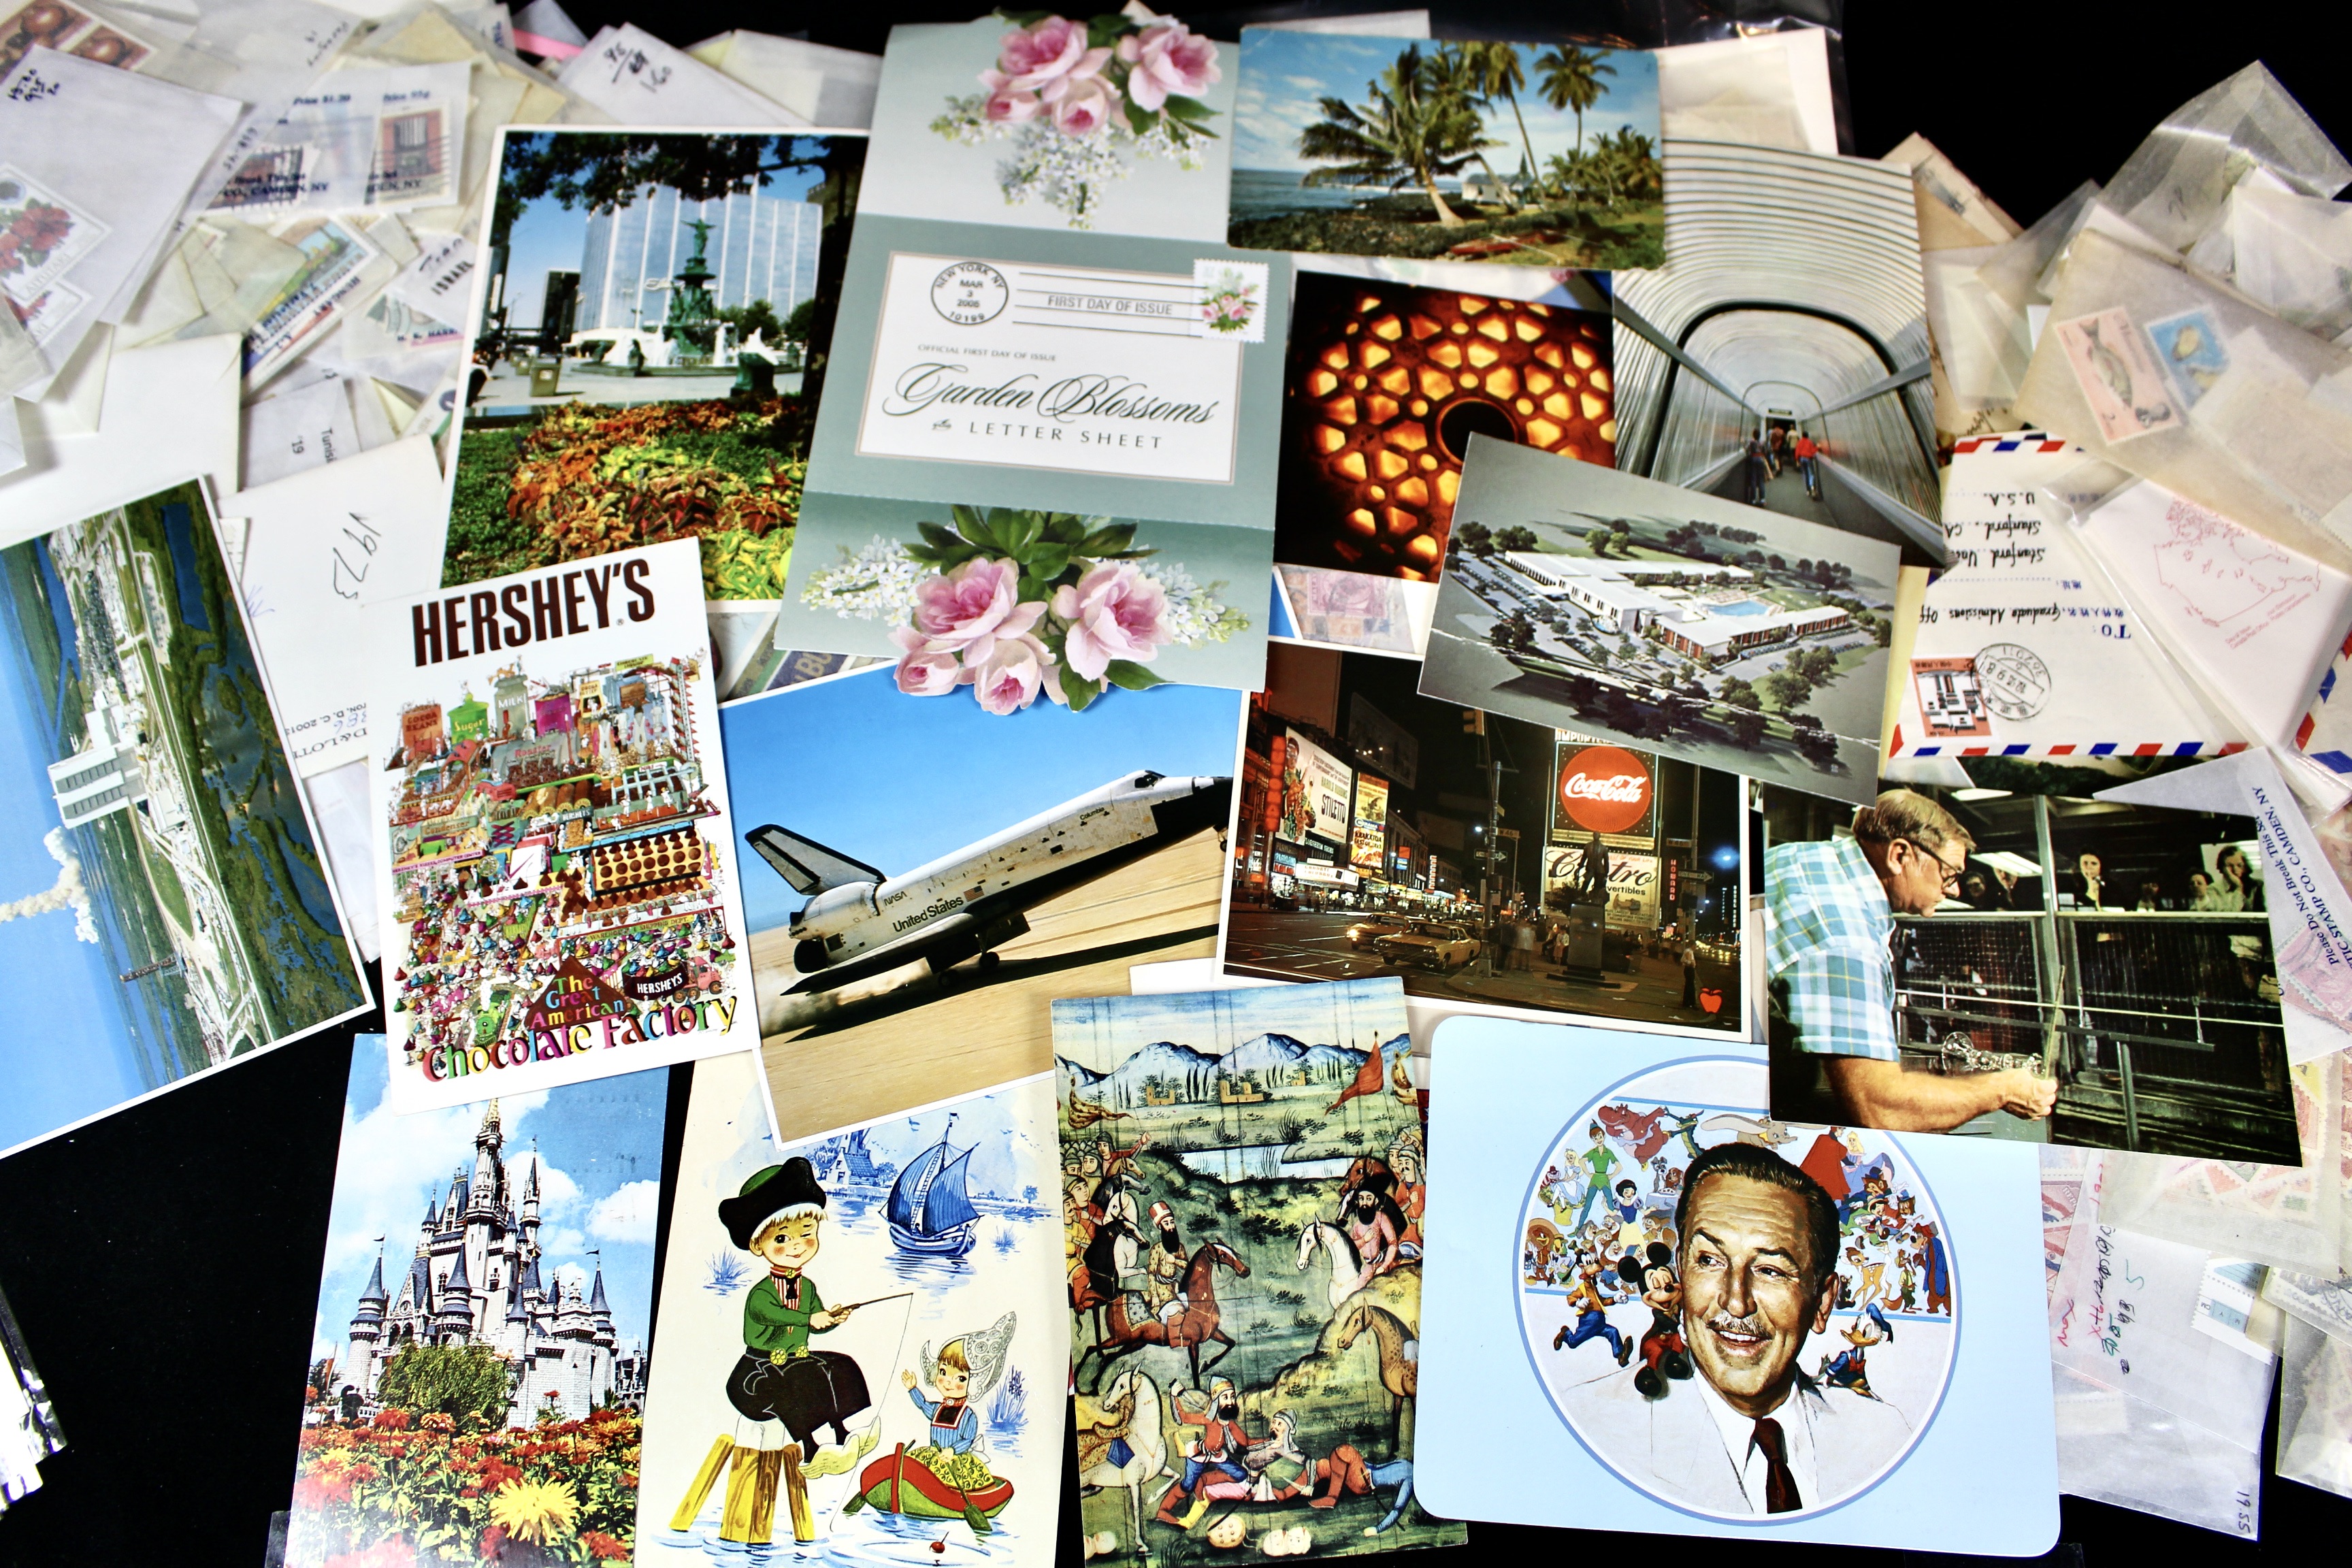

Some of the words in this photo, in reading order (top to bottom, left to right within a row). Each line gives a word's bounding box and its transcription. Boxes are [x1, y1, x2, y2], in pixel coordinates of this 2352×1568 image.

[935, 268, 956, 289] NEW
[958, 263, 991, 276] YORK
[991, 275, 1005, 289] NY
[960, 278, 983, 289] MAR
[1047, 294, 1083, 308] FIRST
[1087, 298, 1112, 310] DAY
[1115, 300, 1133, 312] OF
[1134, 302, 1174, 315] ISSUE
[917, 344, 960, 354] OFFICIAL
[963, 347, 989, 357] FIRST
[991, 350, 1011, 359] DAY
[1013, 352, 1028, 360] OF
[1030, 353, 1056, 362] ISSUE
[882, 362, 1039, 417] Garden
[1036, 373, 1220, 424] Blossoms
[969, 420, 1063, 442] LETTER
[1079, 429, 1164, 450] SHEET
[1983, 491, 2035, 505] U.S.A.
[1990, 541, 2046, 568] Stanford
[411, 558, 655, 667] HERSHEY'S
[1950, 607, 2005, 625] Admissions
[2011, 602, 2061, 625] Graduate
[497, 696, 524, 709] MILK
[453, 717, 485, 733] Sugar
[1565, 772, 1648, 803] Coca-Cola
[2252, 787, 2267, 805] NY
[1079, 806, 1105, 821] Columbia
[1321, 793, 1346, 824] STILETTO
[2254, 815, 2266, 833] Set
[2264, 805, 2301, 866] CAMDEN,
[2261, 833, 2278, 860] This
[2275, 857, 2298, 892] Break
[2299, 866, 2316, 894] CO.,
[884, 890, 908, 906] NASA
[1607, 885, 1646, 896] vertibles
[2294, 889, 2308, 913] Not
[892, 909, 928, 933] United
[926, 896, 964, 918] States
[2303, 910, 2319, 932] Do
[2313, 896, 2344, 943] STAMP
[2317, 928, 2341, 965] Please
[545, 984, 601, 1009] Great
[553, 975, 595, 996] The
[529, 998, 627, 1030] American
[422, 1023, 592, 1083] Chocolate
[602, 995, 738, 1050] Factory
[2200, 1301, 2211, 1311] CM
